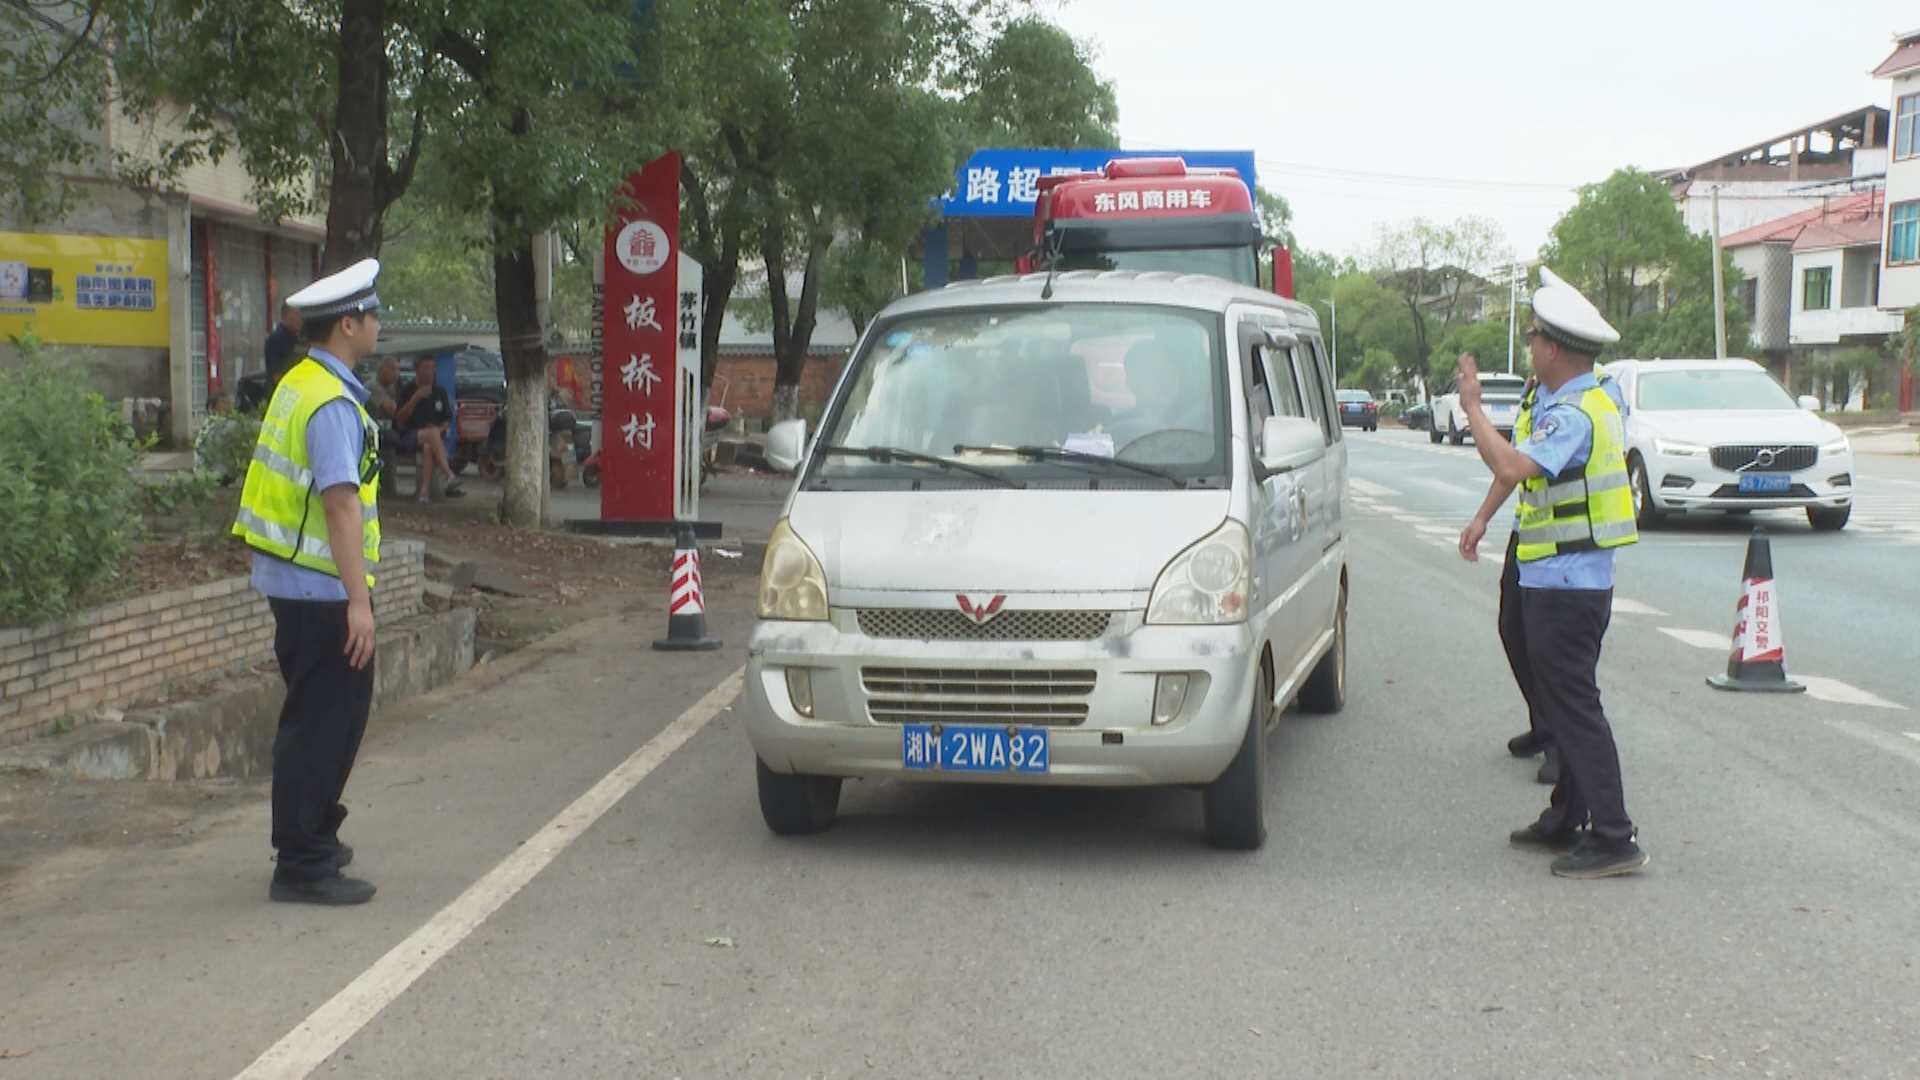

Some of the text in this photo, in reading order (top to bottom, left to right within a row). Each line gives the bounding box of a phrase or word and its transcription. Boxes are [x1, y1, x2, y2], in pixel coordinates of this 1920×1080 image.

[1094, 188, 1212, 213] 东风商用车
[619, 293, 663, 450] 板桥村
